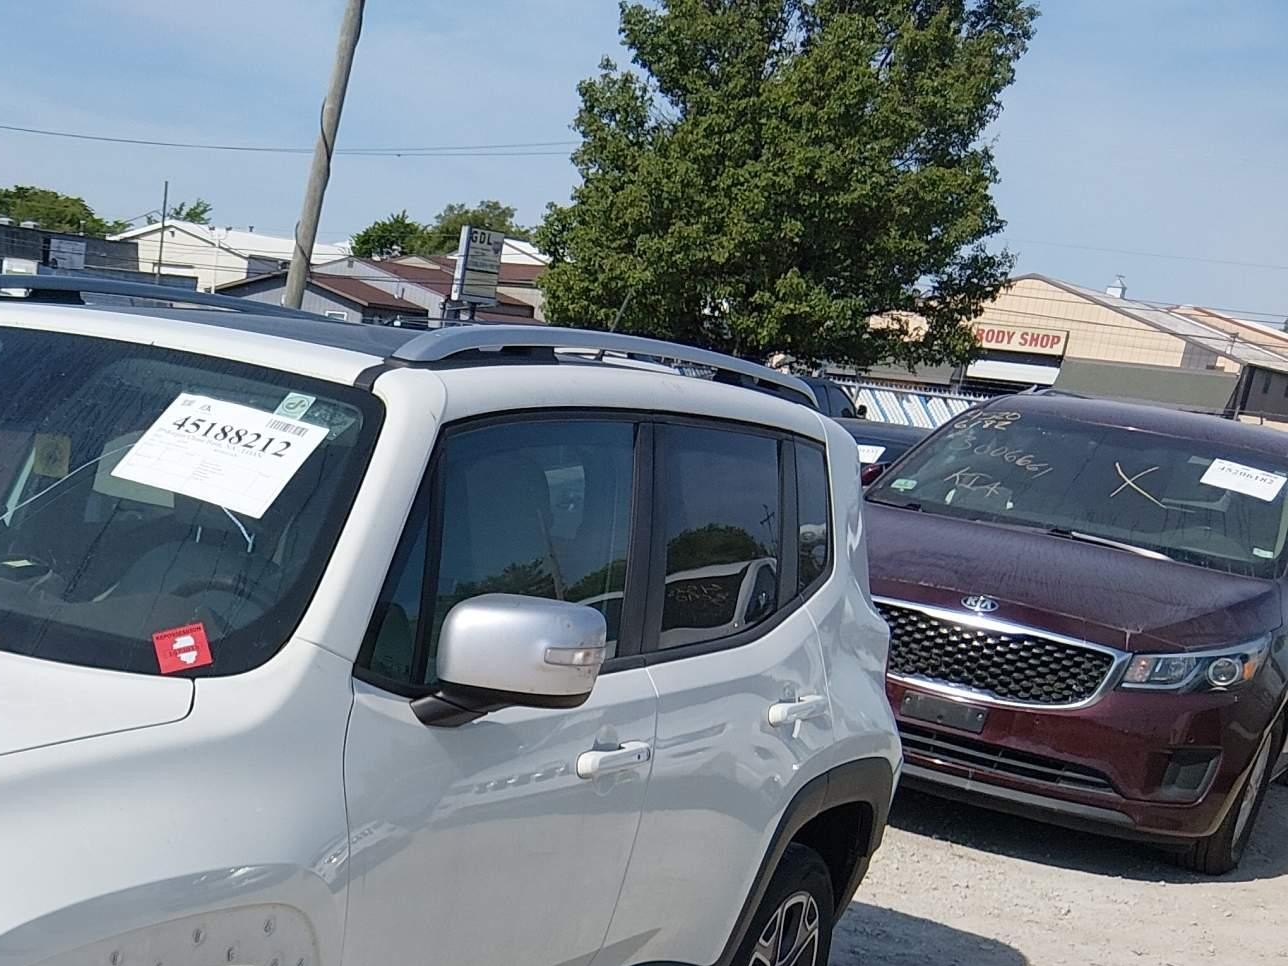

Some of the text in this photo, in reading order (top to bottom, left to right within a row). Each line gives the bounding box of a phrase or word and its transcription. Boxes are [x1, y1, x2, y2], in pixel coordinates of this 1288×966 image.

[471, 230, 493, 246] GDL
[975, 328, 1061, 349] BODY SHOP
[172, 415, 293, 458] 45188212
